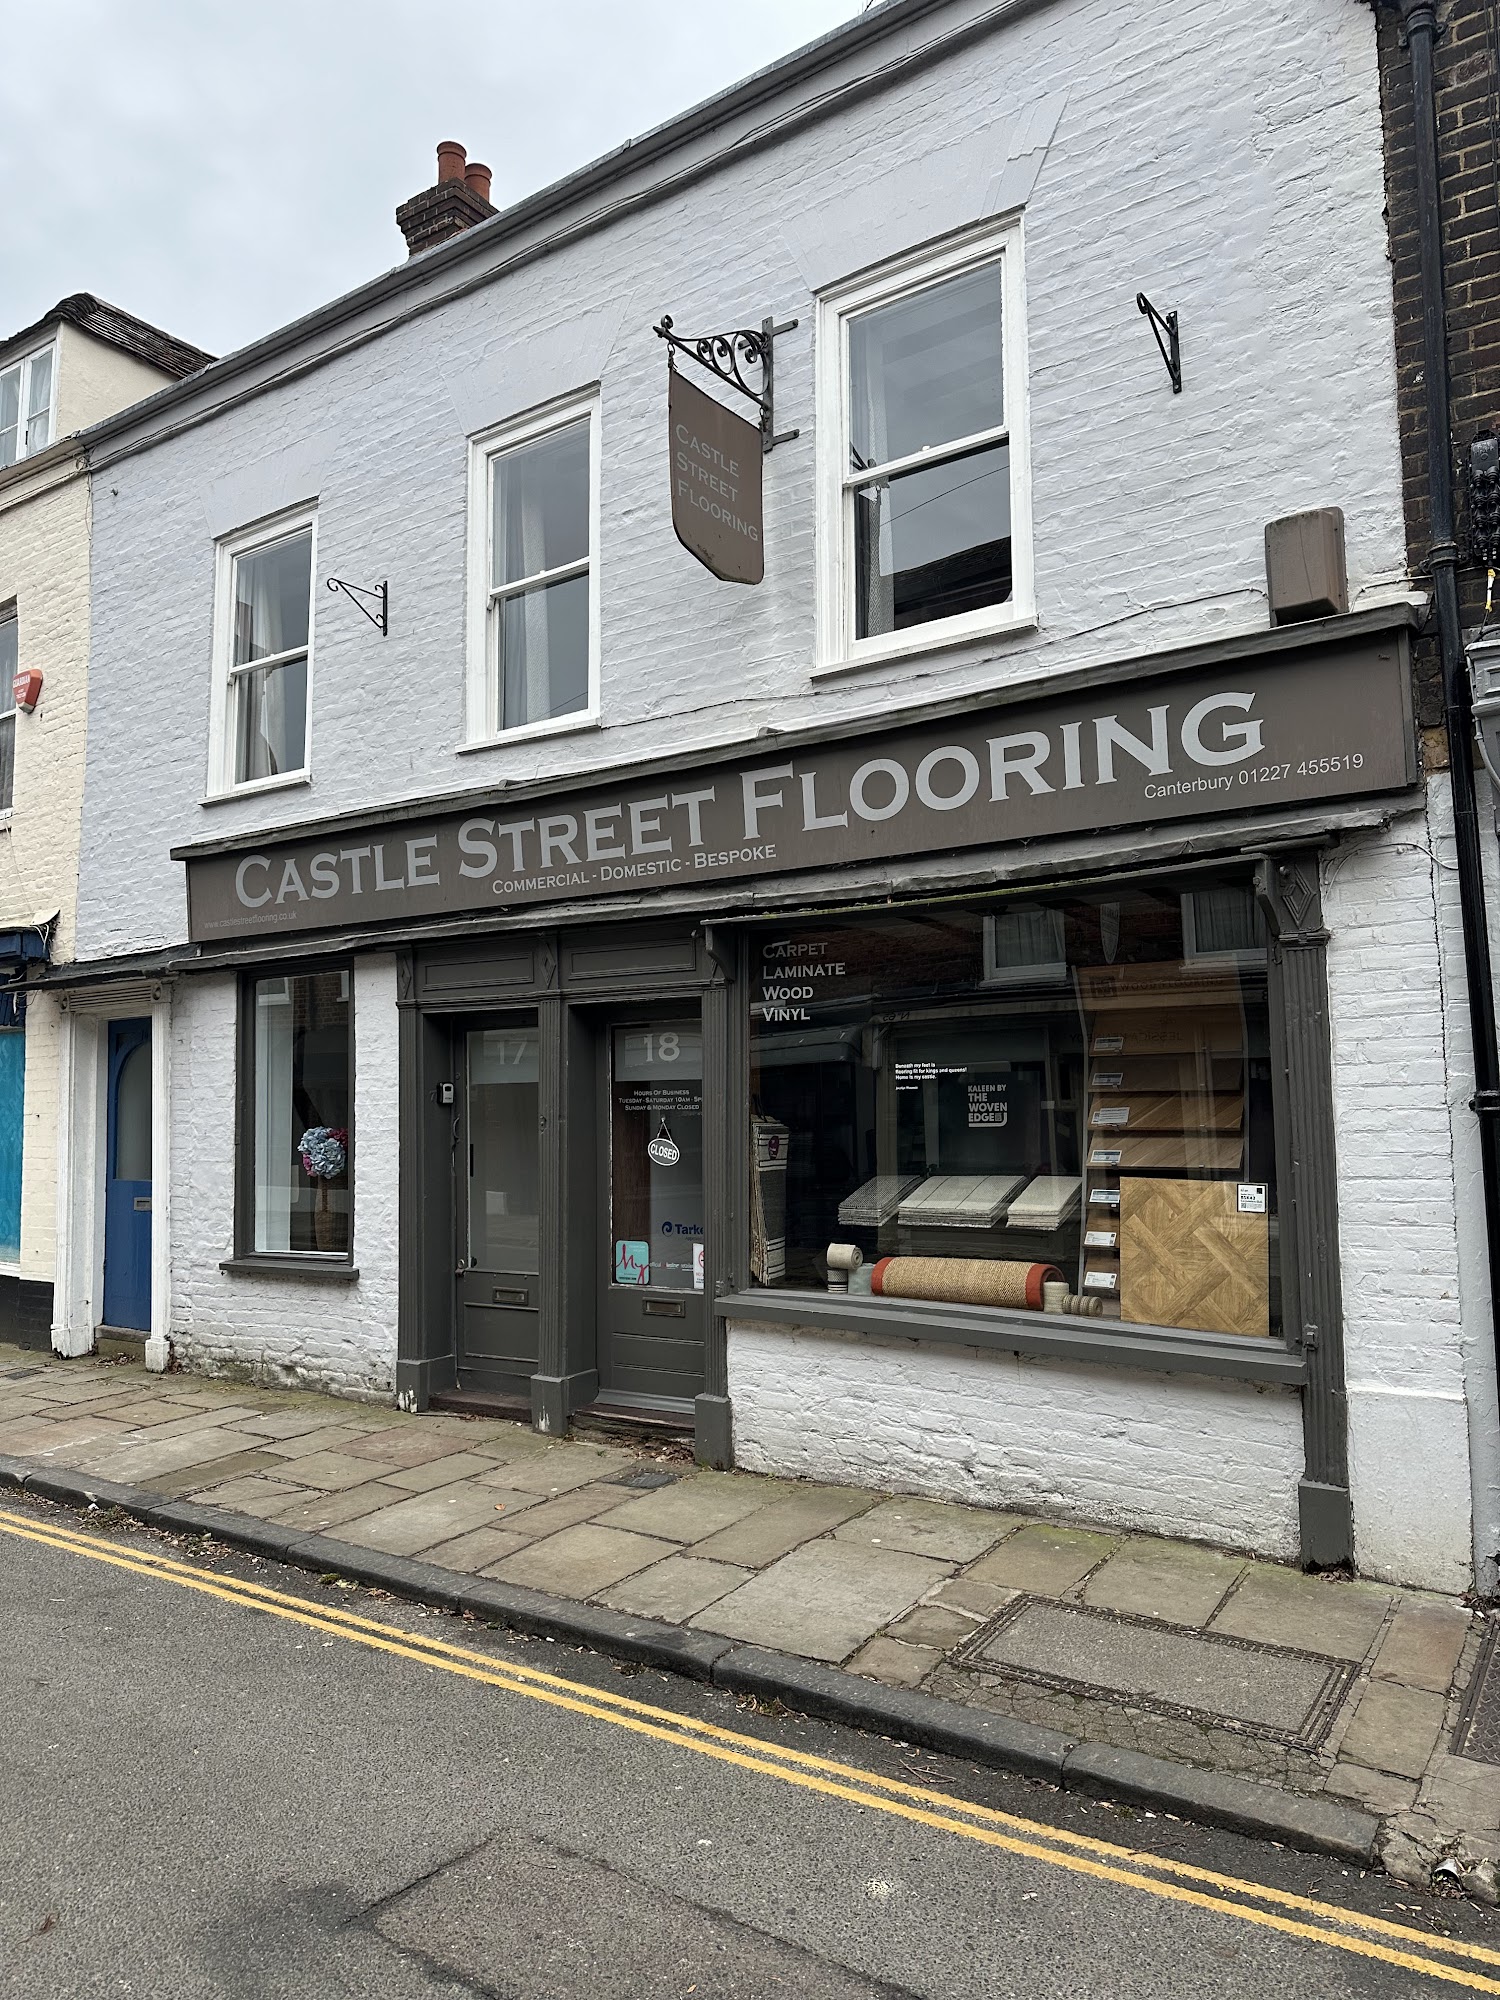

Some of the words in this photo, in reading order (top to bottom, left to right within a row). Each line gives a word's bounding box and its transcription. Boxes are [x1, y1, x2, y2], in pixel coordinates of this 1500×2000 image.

[675, 424, 739, 478] CASTLE
[676, 452, 738, 502] STREET
[678, 479, 758, 541] FLOORING
[1144, 771, 1233, 799] Canterbury
[1238, 763, 1291, 786] 01227
[1297, 753, 1364, 776] 455519
[235, 834, 440, 908] CASTLE
[457, 786, 716, 879] STREET
[739, 692, 1266, 840] FLOORING
[492, 871, 590, 895] COMMERCIAL
[600, 858, 682, 882] DOMESTIC
[694, 844, 777, 870] BESPOKE
[203, 910, 297, 929] www.castlestreetflooring.co.uk
[762, 942, 828, 959] CARPET
[763, 962, 846, 980] LAMINATE
[762, 986, 814, 1001] WOOD
[762, 1007, 811, 1022] VINYL
[496, 1036, 529, 1065] 17
[644, 1031, 680, 1062] 18
[926, 1067, 938, 1075] kings
[968, 1092, 987, 1102] THE
[997, 1084, 1006, 1092] BY
[968, 1102, 1008, 1112] WOVEN
[968, 1113, 995, 1122] EDGE
[650, 1143, 677, 1161] CLOSED
